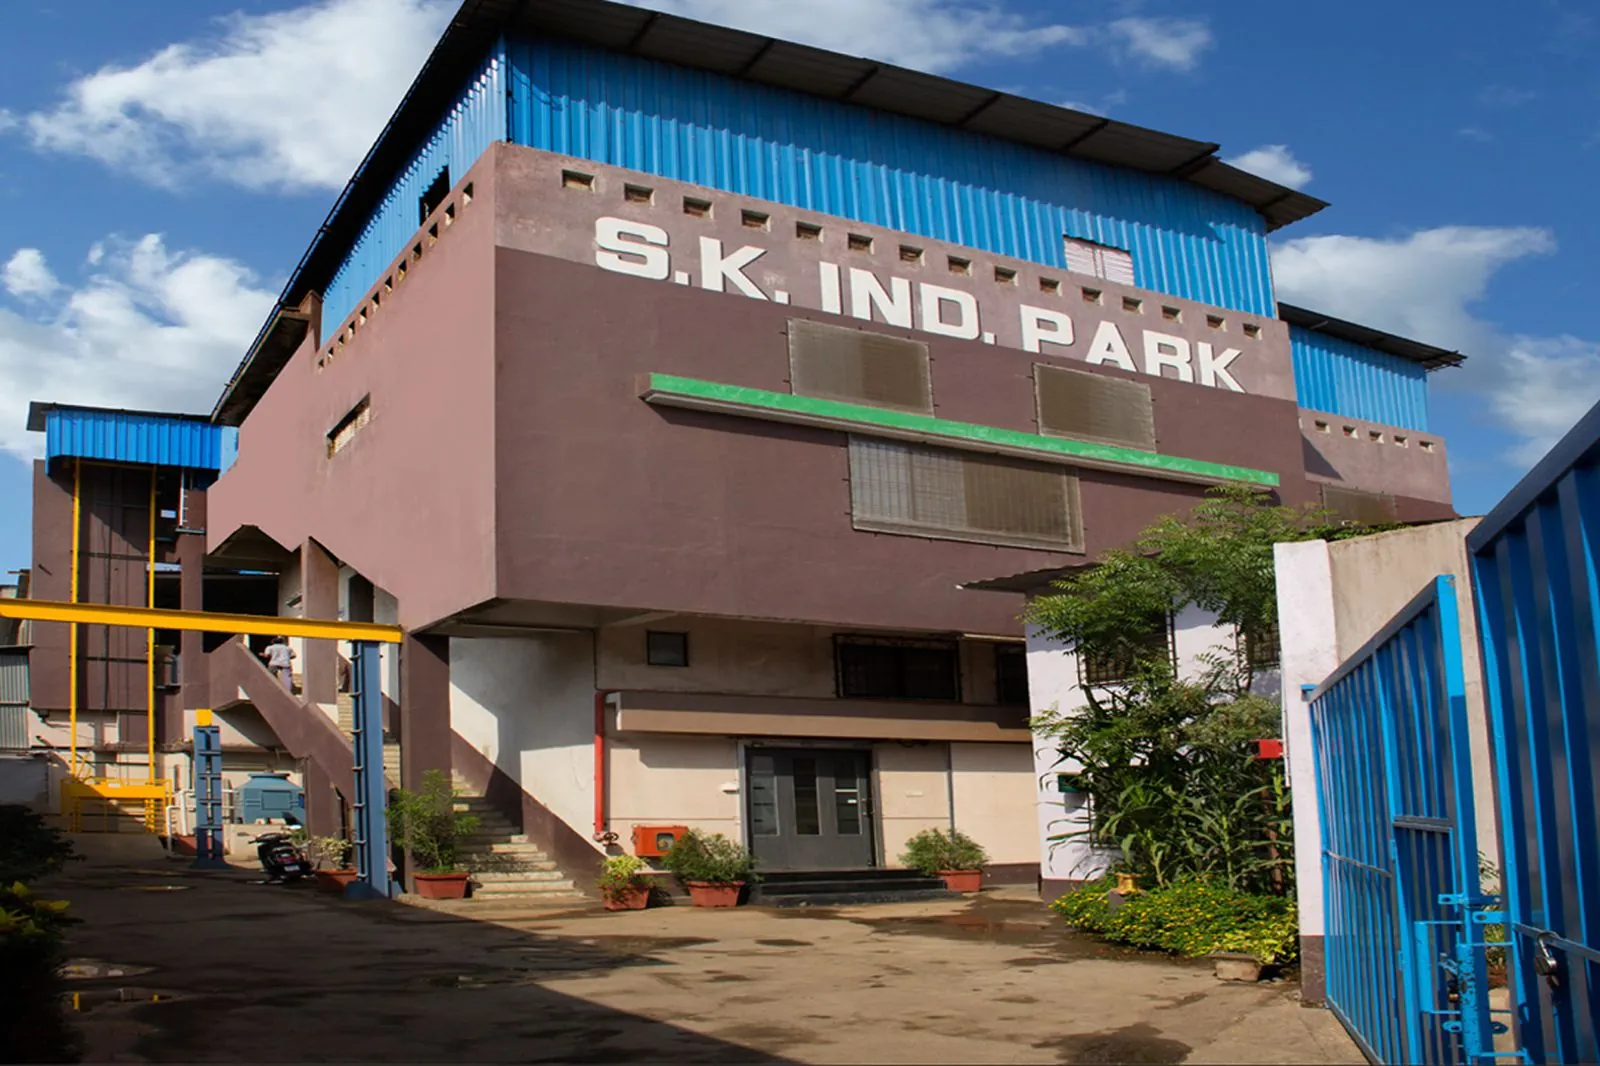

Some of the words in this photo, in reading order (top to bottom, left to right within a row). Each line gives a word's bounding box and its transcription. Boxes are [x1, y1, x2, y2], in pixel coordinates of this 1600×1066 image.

[594, 216, 789, 305] S.K.
[819, 260, 995, 345] IND.
[1019, 304, 1245, 394] PARK
